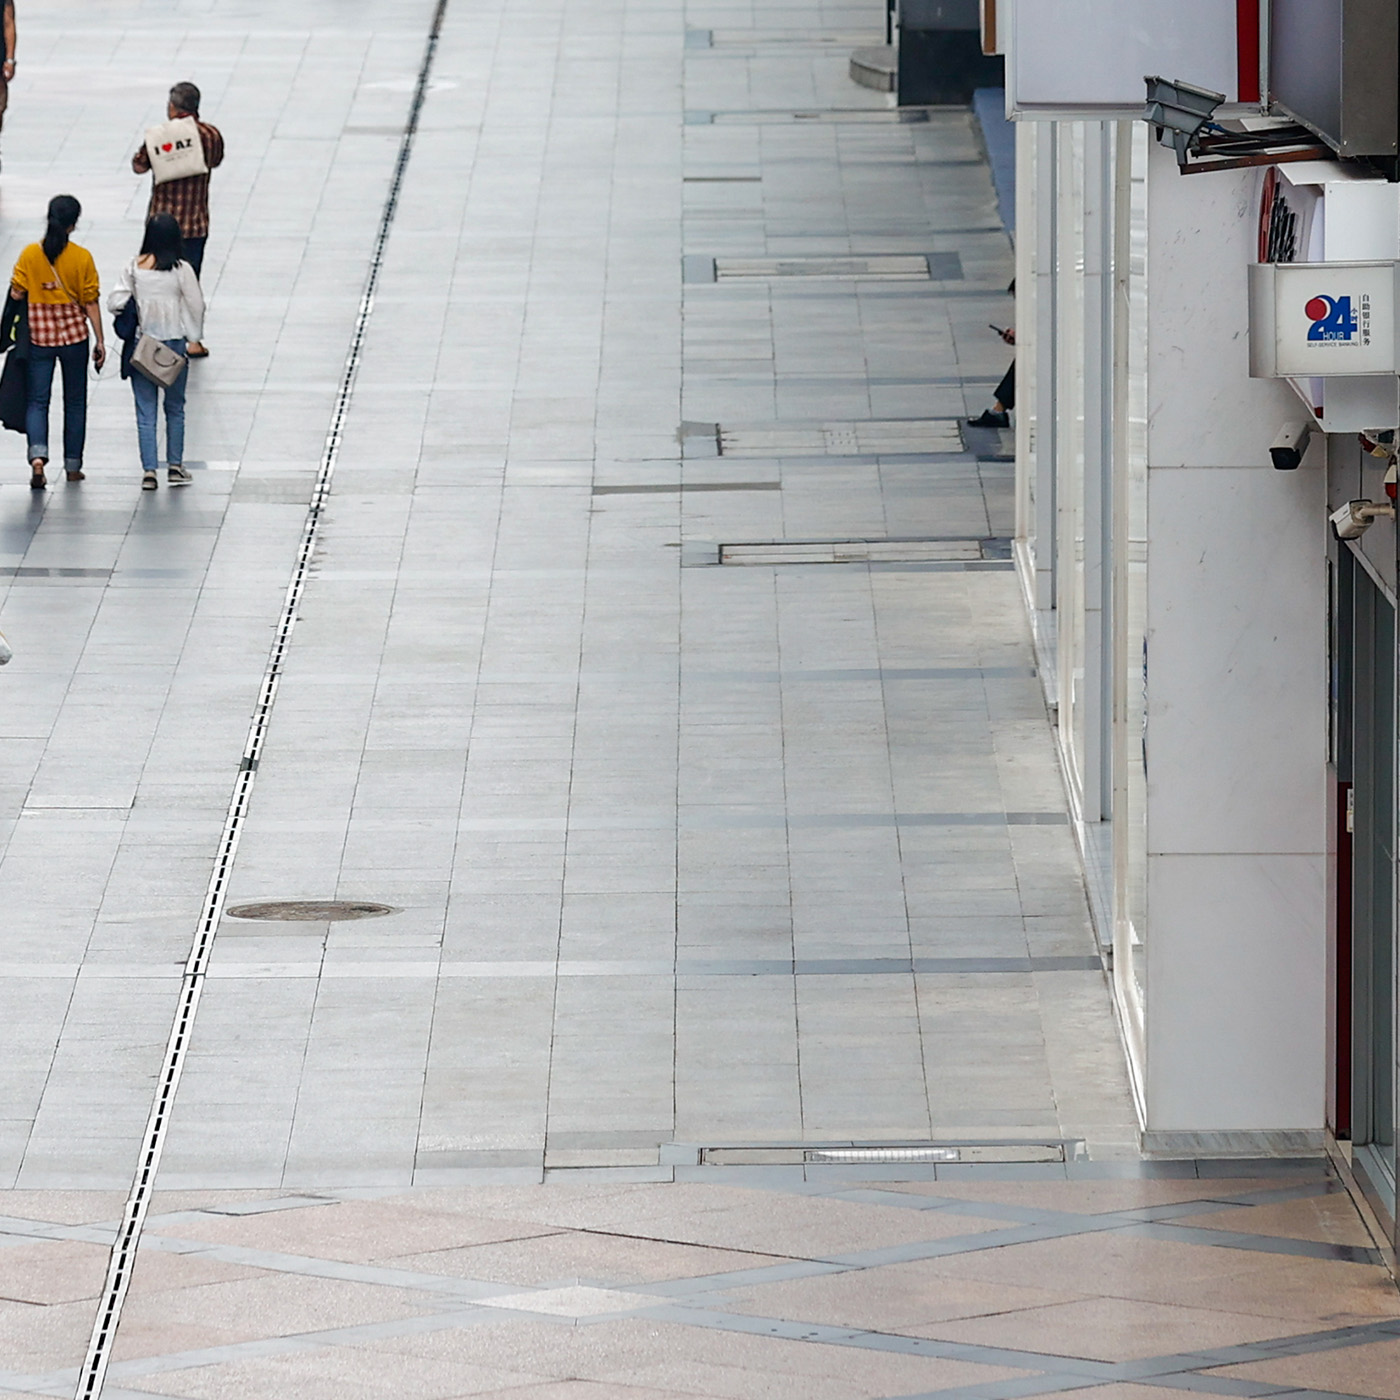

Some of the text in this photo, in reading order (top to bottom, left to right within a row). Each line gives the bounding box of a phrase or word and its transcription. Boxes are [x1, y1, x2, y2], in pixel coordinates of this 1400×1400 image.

[1362, 294, 1371, 346] 自助银行服务
[1322, 331, 1345, 341] HOUR
